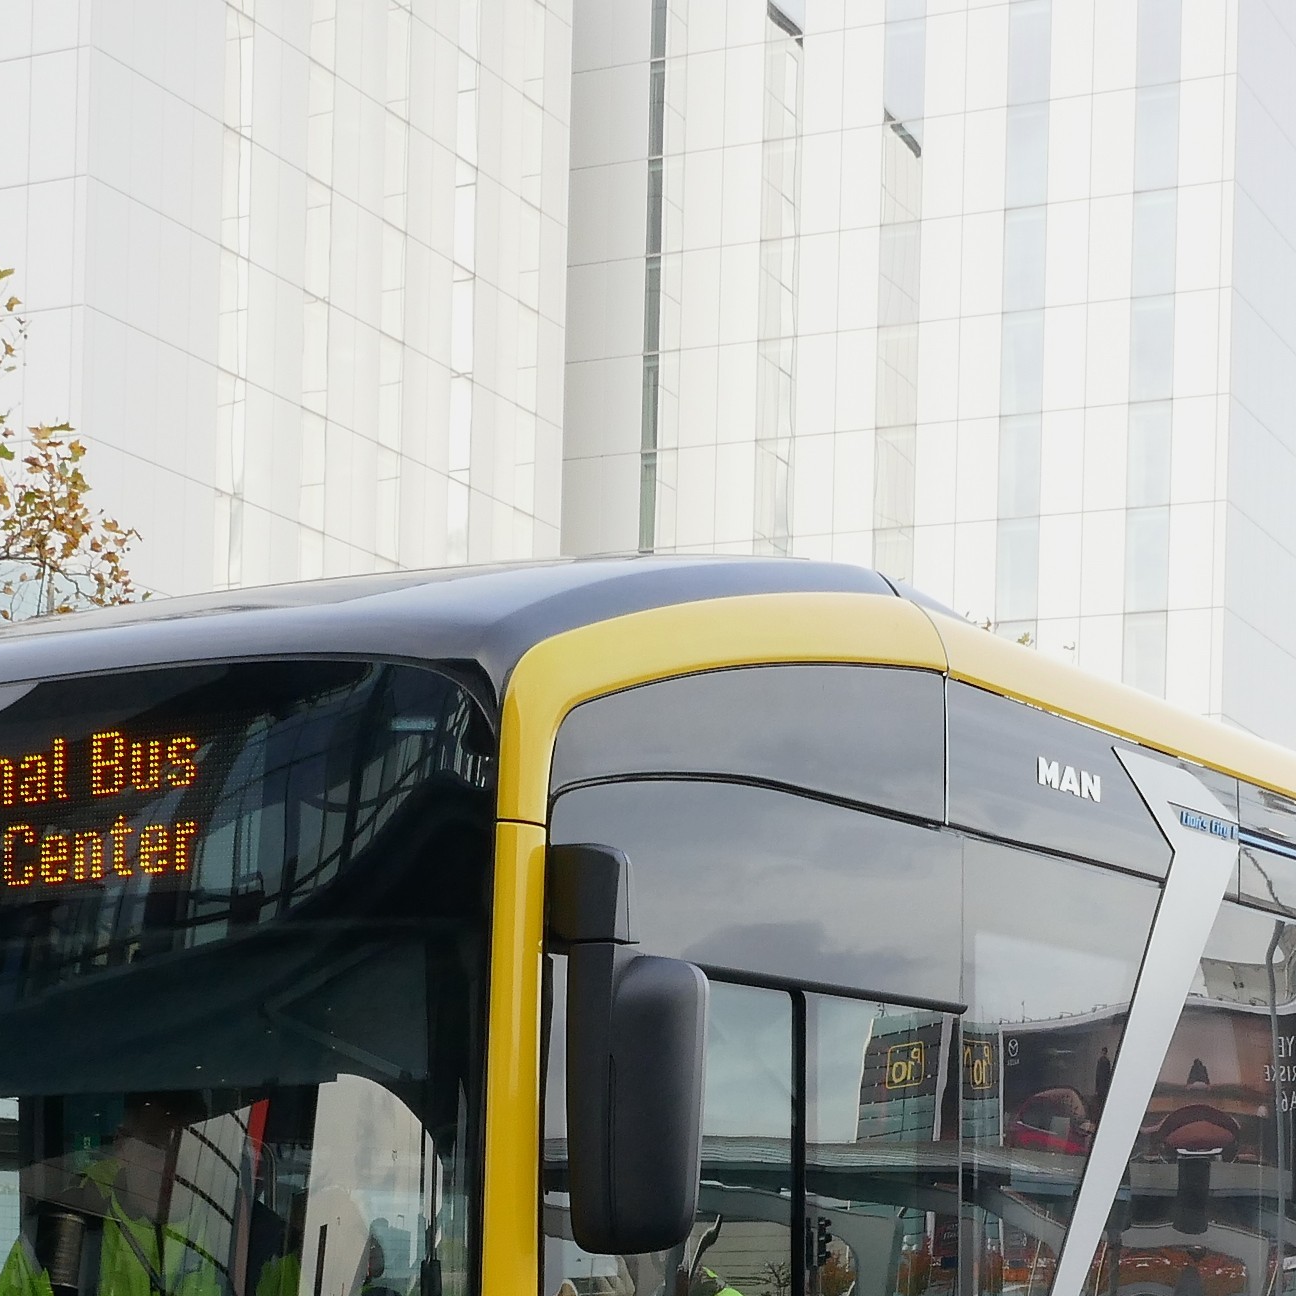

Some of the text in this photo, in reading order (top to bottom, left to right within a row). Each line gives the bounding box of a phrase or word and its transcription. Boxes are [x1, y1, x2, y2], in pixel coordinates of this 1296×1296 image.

[91, 729, 199, 797] Bus
[1037, 756, 1102, 803] MAN
[4, 813, 199, 888] Center
